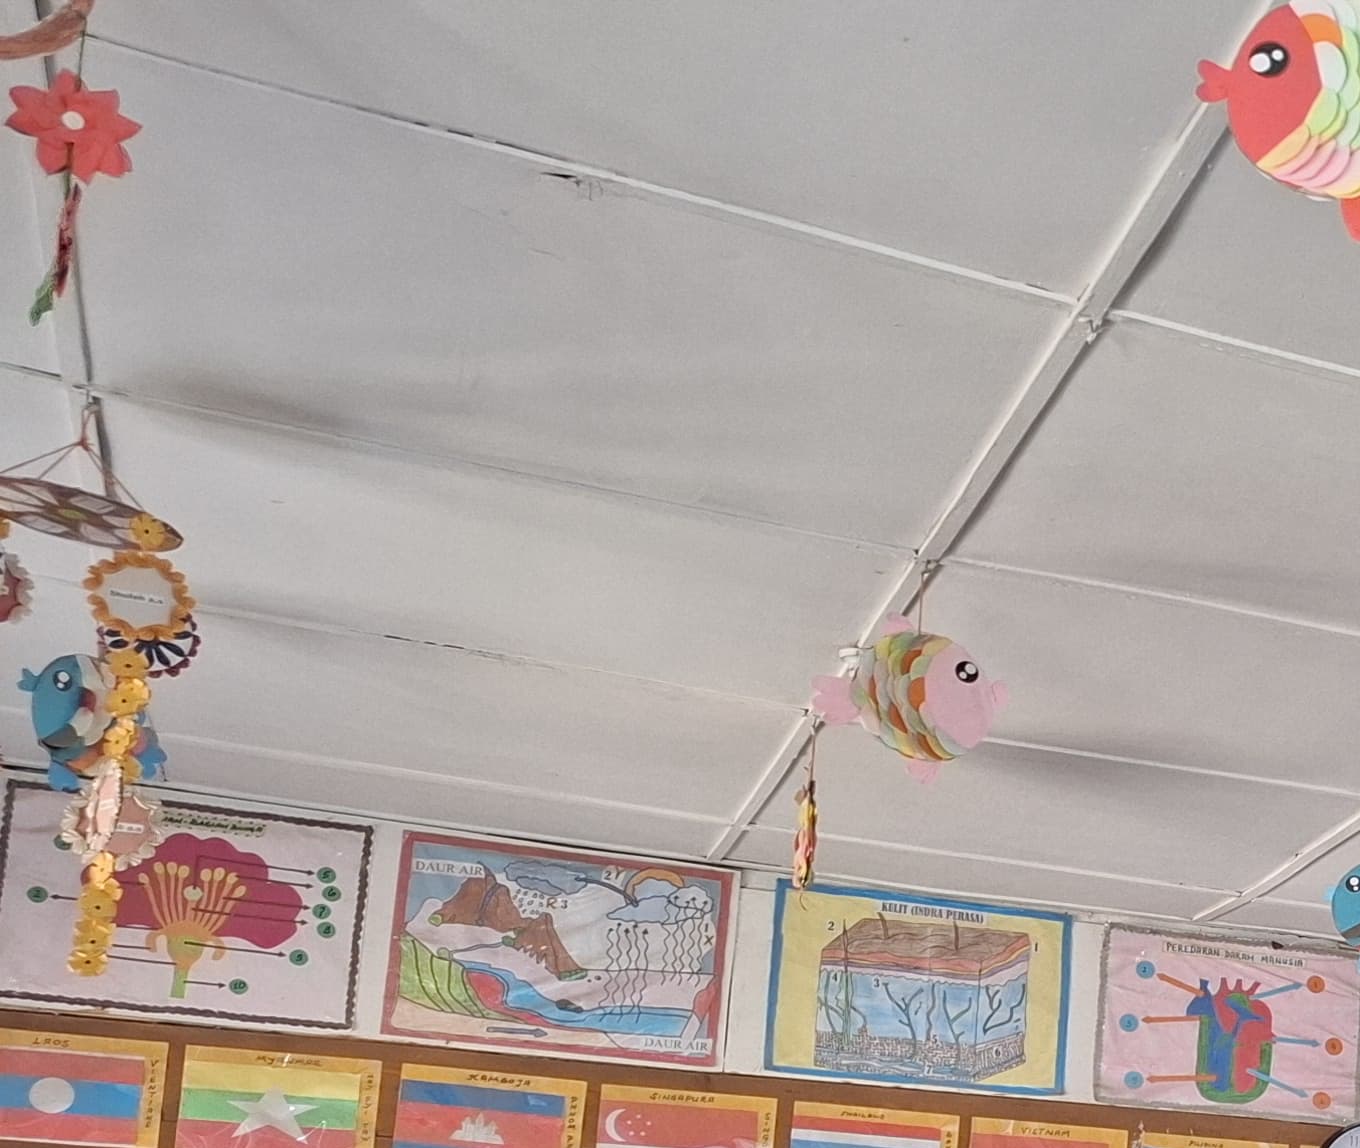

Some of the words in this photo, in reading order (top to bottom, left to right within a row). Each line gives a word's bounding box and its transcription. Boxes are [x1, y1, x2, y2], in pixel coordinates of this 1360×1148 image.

[415, 860, 456, 873] DAUR
[458, 864, 483, 876] AIR
[880, 901, 907, 914] KULIT
[910, 905, 944, 919] (INDRA
[945, 910, 985, 925] PERASA)
[827, 921, 834, 931] 2
[873, 978, 881, 988] 3
[32, 1037, 70, 1048] LAOS
[644, 1037, 683, 1049] DAUR
[685, 1040, 708, 1052] AIR
[649, 1092, 716, 1104] SINGAPURA
[1020, 1126, 1070, 1139] VIETNAM
[1349, 1135, 1359, 1147] 11
